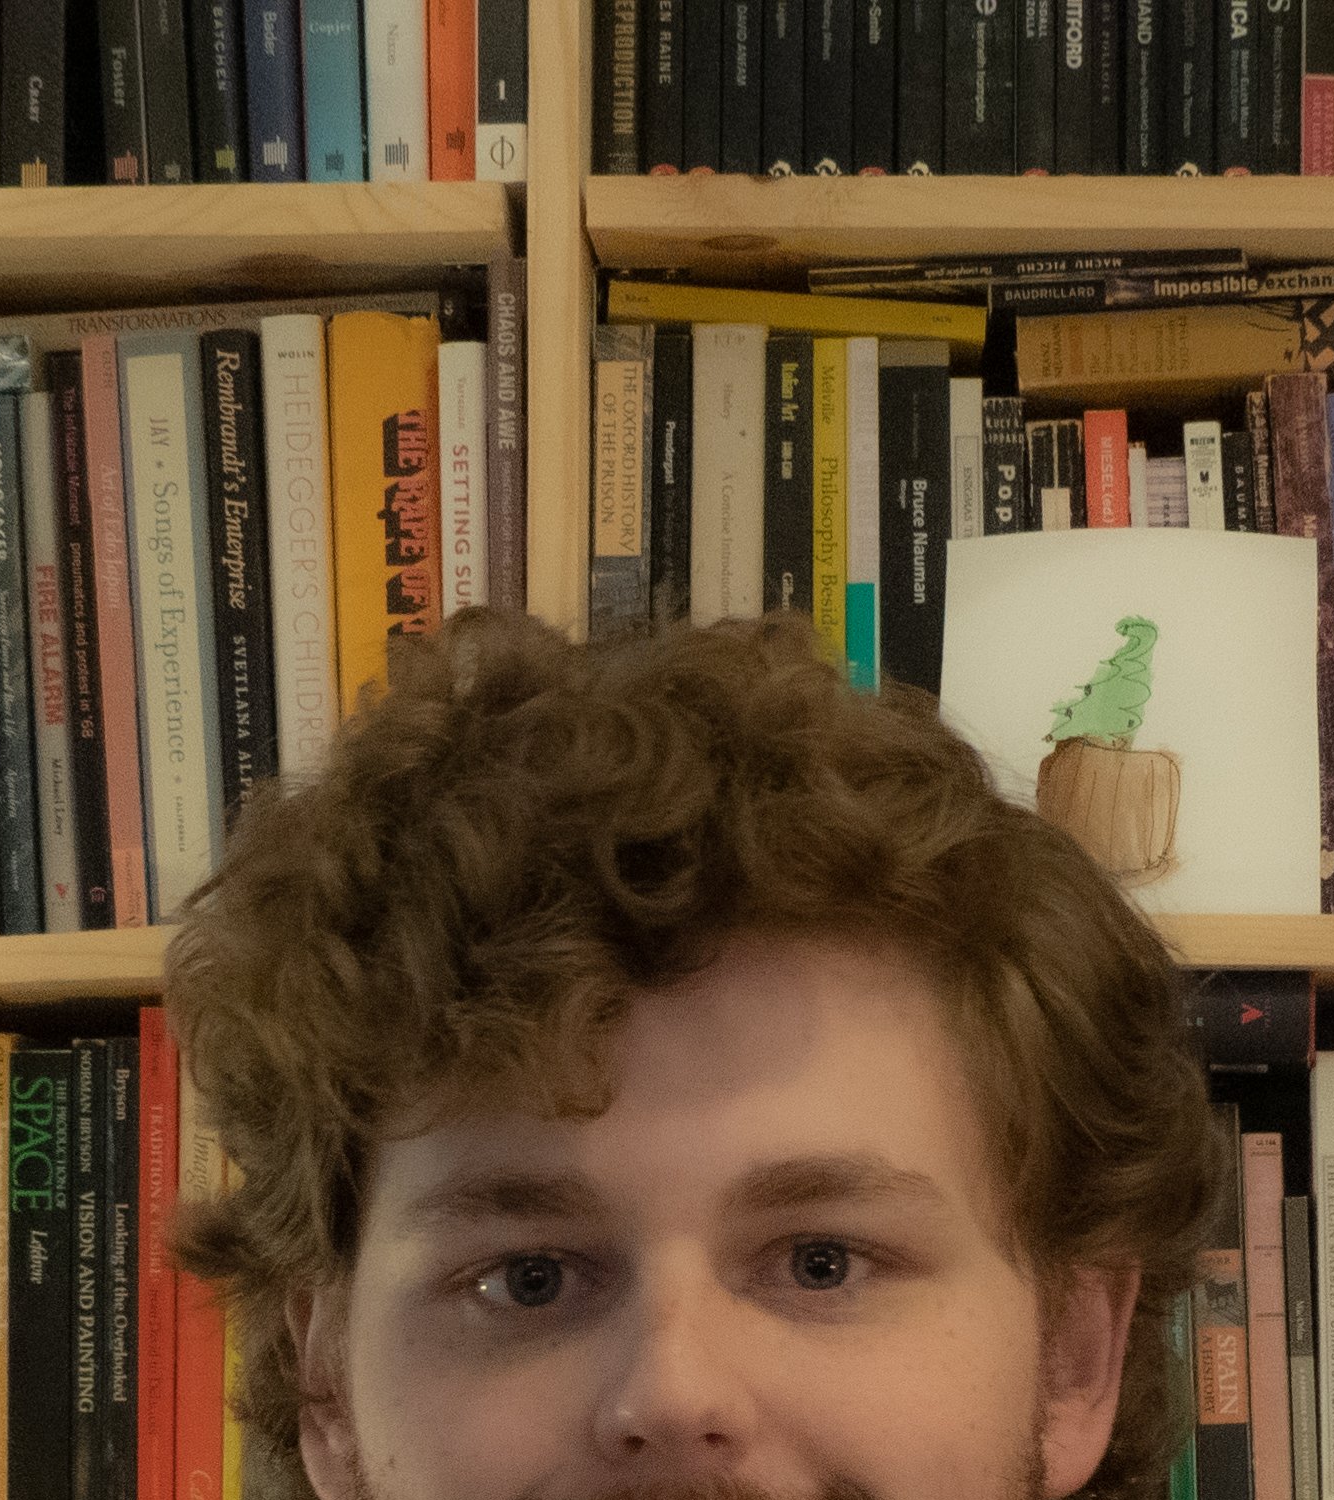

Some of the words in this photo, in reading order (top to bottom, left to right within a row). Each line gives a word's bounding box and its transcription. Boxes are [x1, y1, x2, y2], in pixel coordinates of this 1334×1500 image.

[111, 47, 128, 107] Foster
[1005, 286, 1094, 300] BAUDRILLARD
[600, 393, 616, 415] OF
[623, 366, 638, 398] THE
[148, 417, 170, 448] JAY
[215, 349, 246, 492] Rembrandt's
[601, 420, 616, 454] THE
[623, 402, 638, 473] OXFORD
[152, 480, 182, 565] Songs
[601, 458, 617, 524] PRISON
[621, 476, 638, 553] HISTORY
[913, 478, 928, 527] Bruce
[158, 572, 185, 599] of
[224, 499, 250, 609] Enterprise
[913, 533, 928, 604] Nauman
[36, 565, 60, 624] FIRE
[41, 634, 64, 725] ALARM
[156, 608, 189, 763] Experience
[12, 1076, 53, 1214] SPACE
[78, 1191, 95, 1259] VISION
[78, 1266, 95, 1310] AND
[78, 1316, 95, 1413] PAINTING
